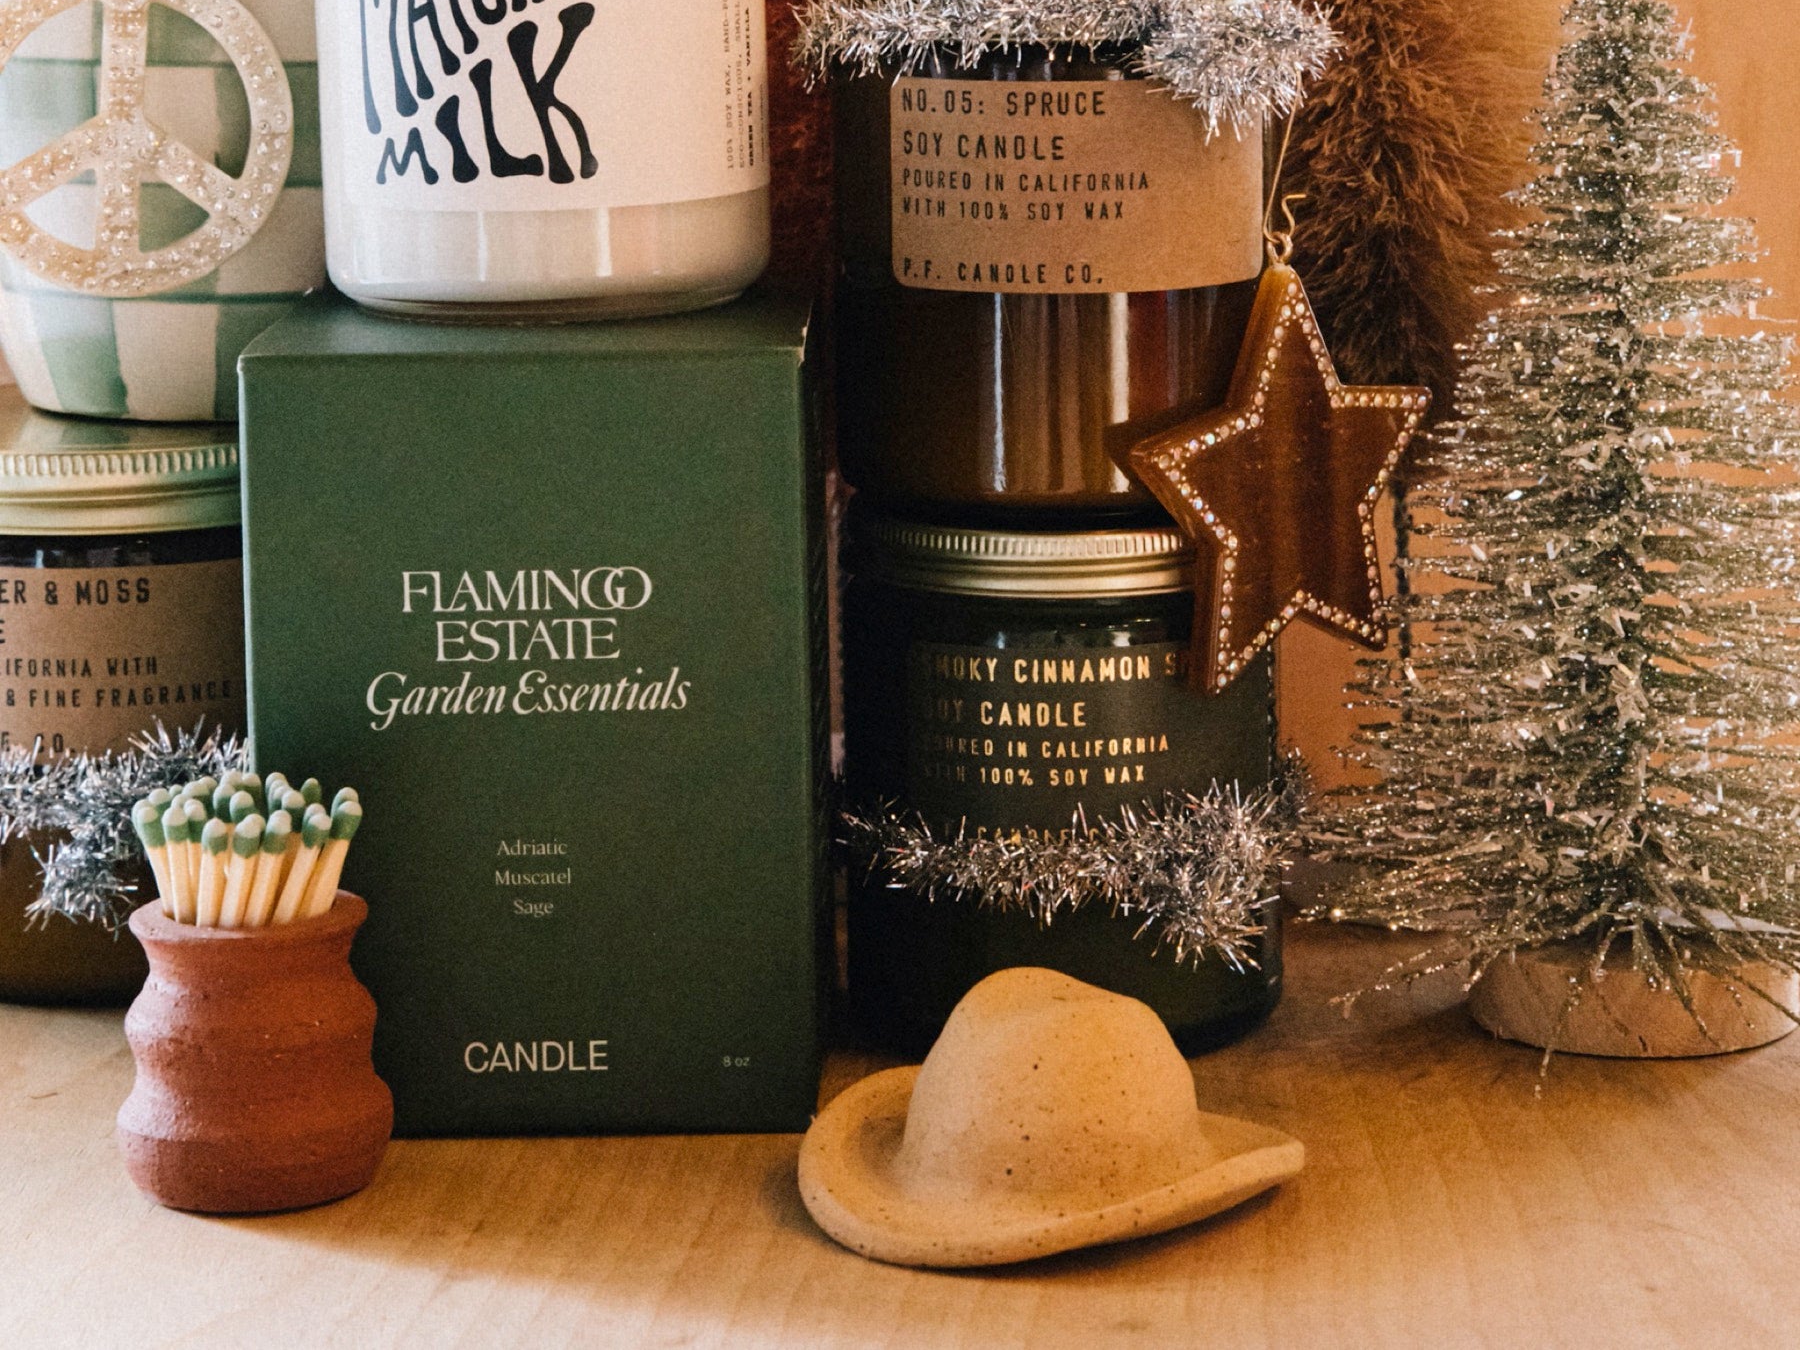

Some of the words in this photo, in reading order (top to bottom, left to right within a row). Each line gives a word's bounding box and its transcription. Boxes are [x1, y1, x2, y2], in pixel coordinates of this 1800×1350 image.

[733, 1, 742, 42] SMALL
[376, 2, 599, 185] MILK
[1006, 90, 1106, 116] SPRUCE
[724, 104, 734, 128] SOY
[904, 131, 943, 157] SOY
[957, 134, 1065, 161] CANDLE
[903, 168, 972, 190] POURED
[985, 173, 1005, 191] IN
[1019, 171, 1150, 192] CALIFORNIA
[903, 197, 946, 218] WITH
[959, 201, 1008, 221] 100%
[1028, 201, 1064, 221] SOY
[1085, 201, 1124, 220] WAX
[903, 257, 941, 279] P.F.
[957, 262, 1046, 284] CANDLE
[45, 581, 58, 605] &
[76, 577, 150, 606] MOSS
[401, 566, 653, 613] FLAMINGO
[436, 617, 621, 662] ESTATE
[0, 658, 92, 677] IFORNIA
[106, 656, 158, 676] WITH
[1014, 654, 1150, 684] CINNAMON
[29, 689, 81, 708] FINE
[96, 679, 233, 708] FRAGRANCE
[366, 671, 506, 730] Garden
[512, 666, 691, 715] Essentials
[980, 700, 1087, 728] CANDLE
[1007, 740, 1028, 758] IN
[1041, 734, 1169, 759] CALIFORNIA
[979, 765, 1034, 787] 100%
[1050, 768, 1088, 787] SOY
[1105, 764, 1145, 785] WAX
[497, 838, 568, 856] Adriatic
[495, 868, 571, 885] Muscatel
[513, 899, 554, 918] Sage
[464, 1039, 609, 1073] CANDLE
[722, 1055, 732, 1068] 8
[735, 1056, 750, 1068] oz
